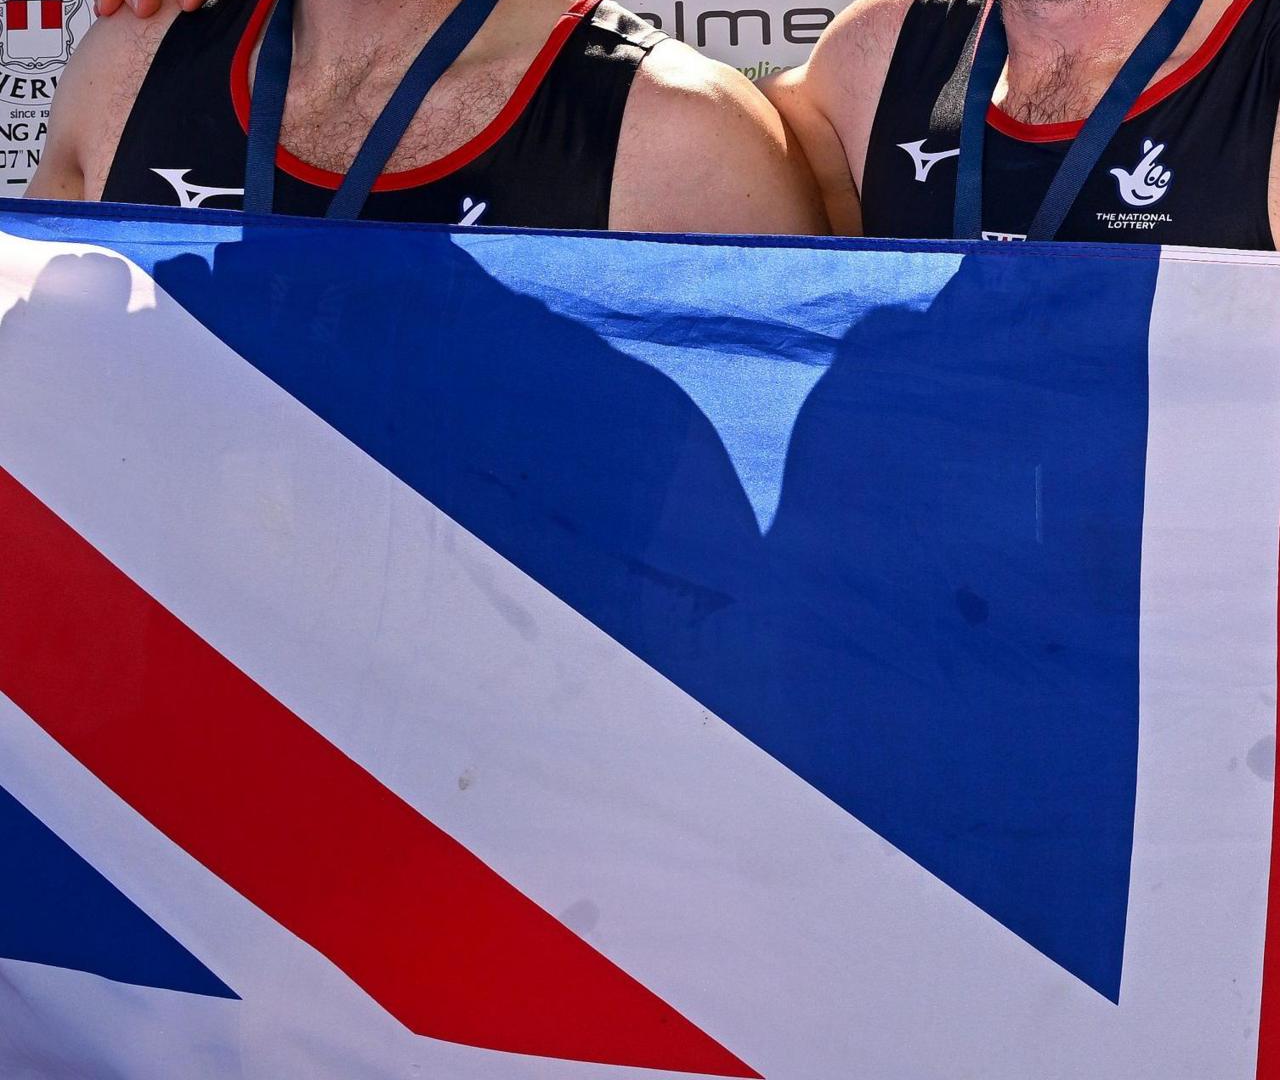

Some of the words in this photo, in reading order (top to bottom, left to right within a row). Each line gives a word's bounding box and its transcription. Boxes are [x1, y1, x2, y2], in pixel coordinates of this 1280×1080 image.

[10, 108, 36, 119] since
[1096, 212, 1117, 221] THE
[1118, 213, 1173, 223] NATIONAL
[1108, 221, 1156, 229] LOTTERY
